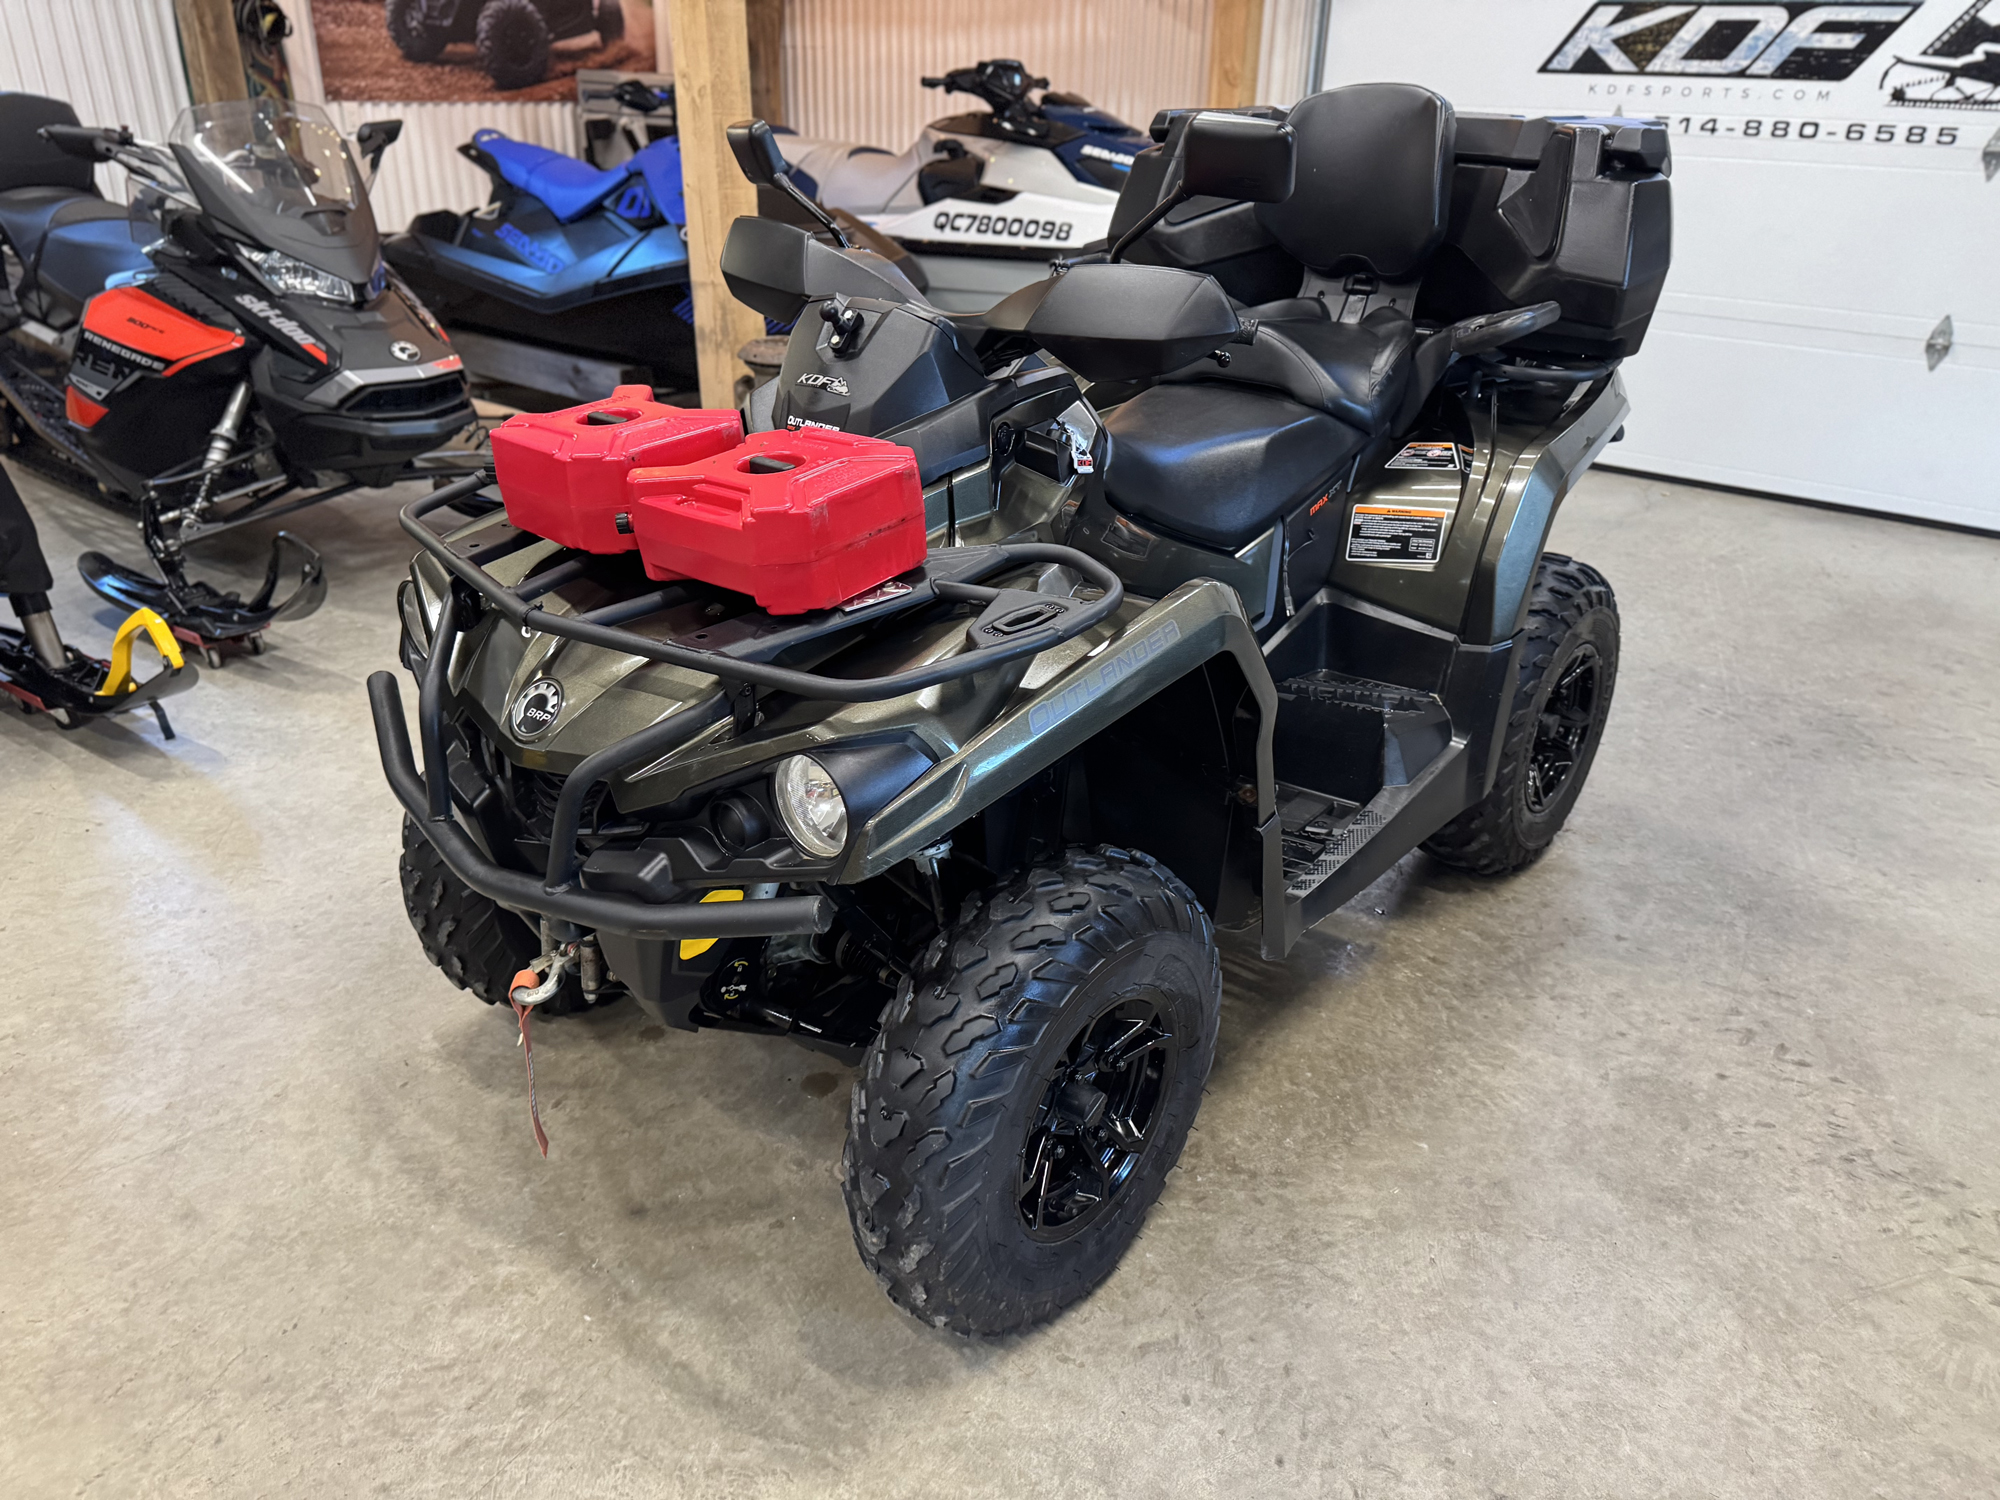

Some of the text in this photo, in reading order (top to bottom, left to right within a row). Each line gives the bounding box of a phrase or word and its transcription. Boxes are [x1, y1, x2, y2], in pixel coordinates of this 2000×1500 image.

[1545, 4, 1914, 76] KDF
[1587, 83, 1832, 103] KDFSPORTS.COM
[933, 212, 1074, 241] QC7800098
[83, 330, 166, 371] RENEGADE
[797, 373, 838, 386] KDF
[1028, 618, 1182, 735] OUTLANDER
[526, 707, 552, 722] BRP
